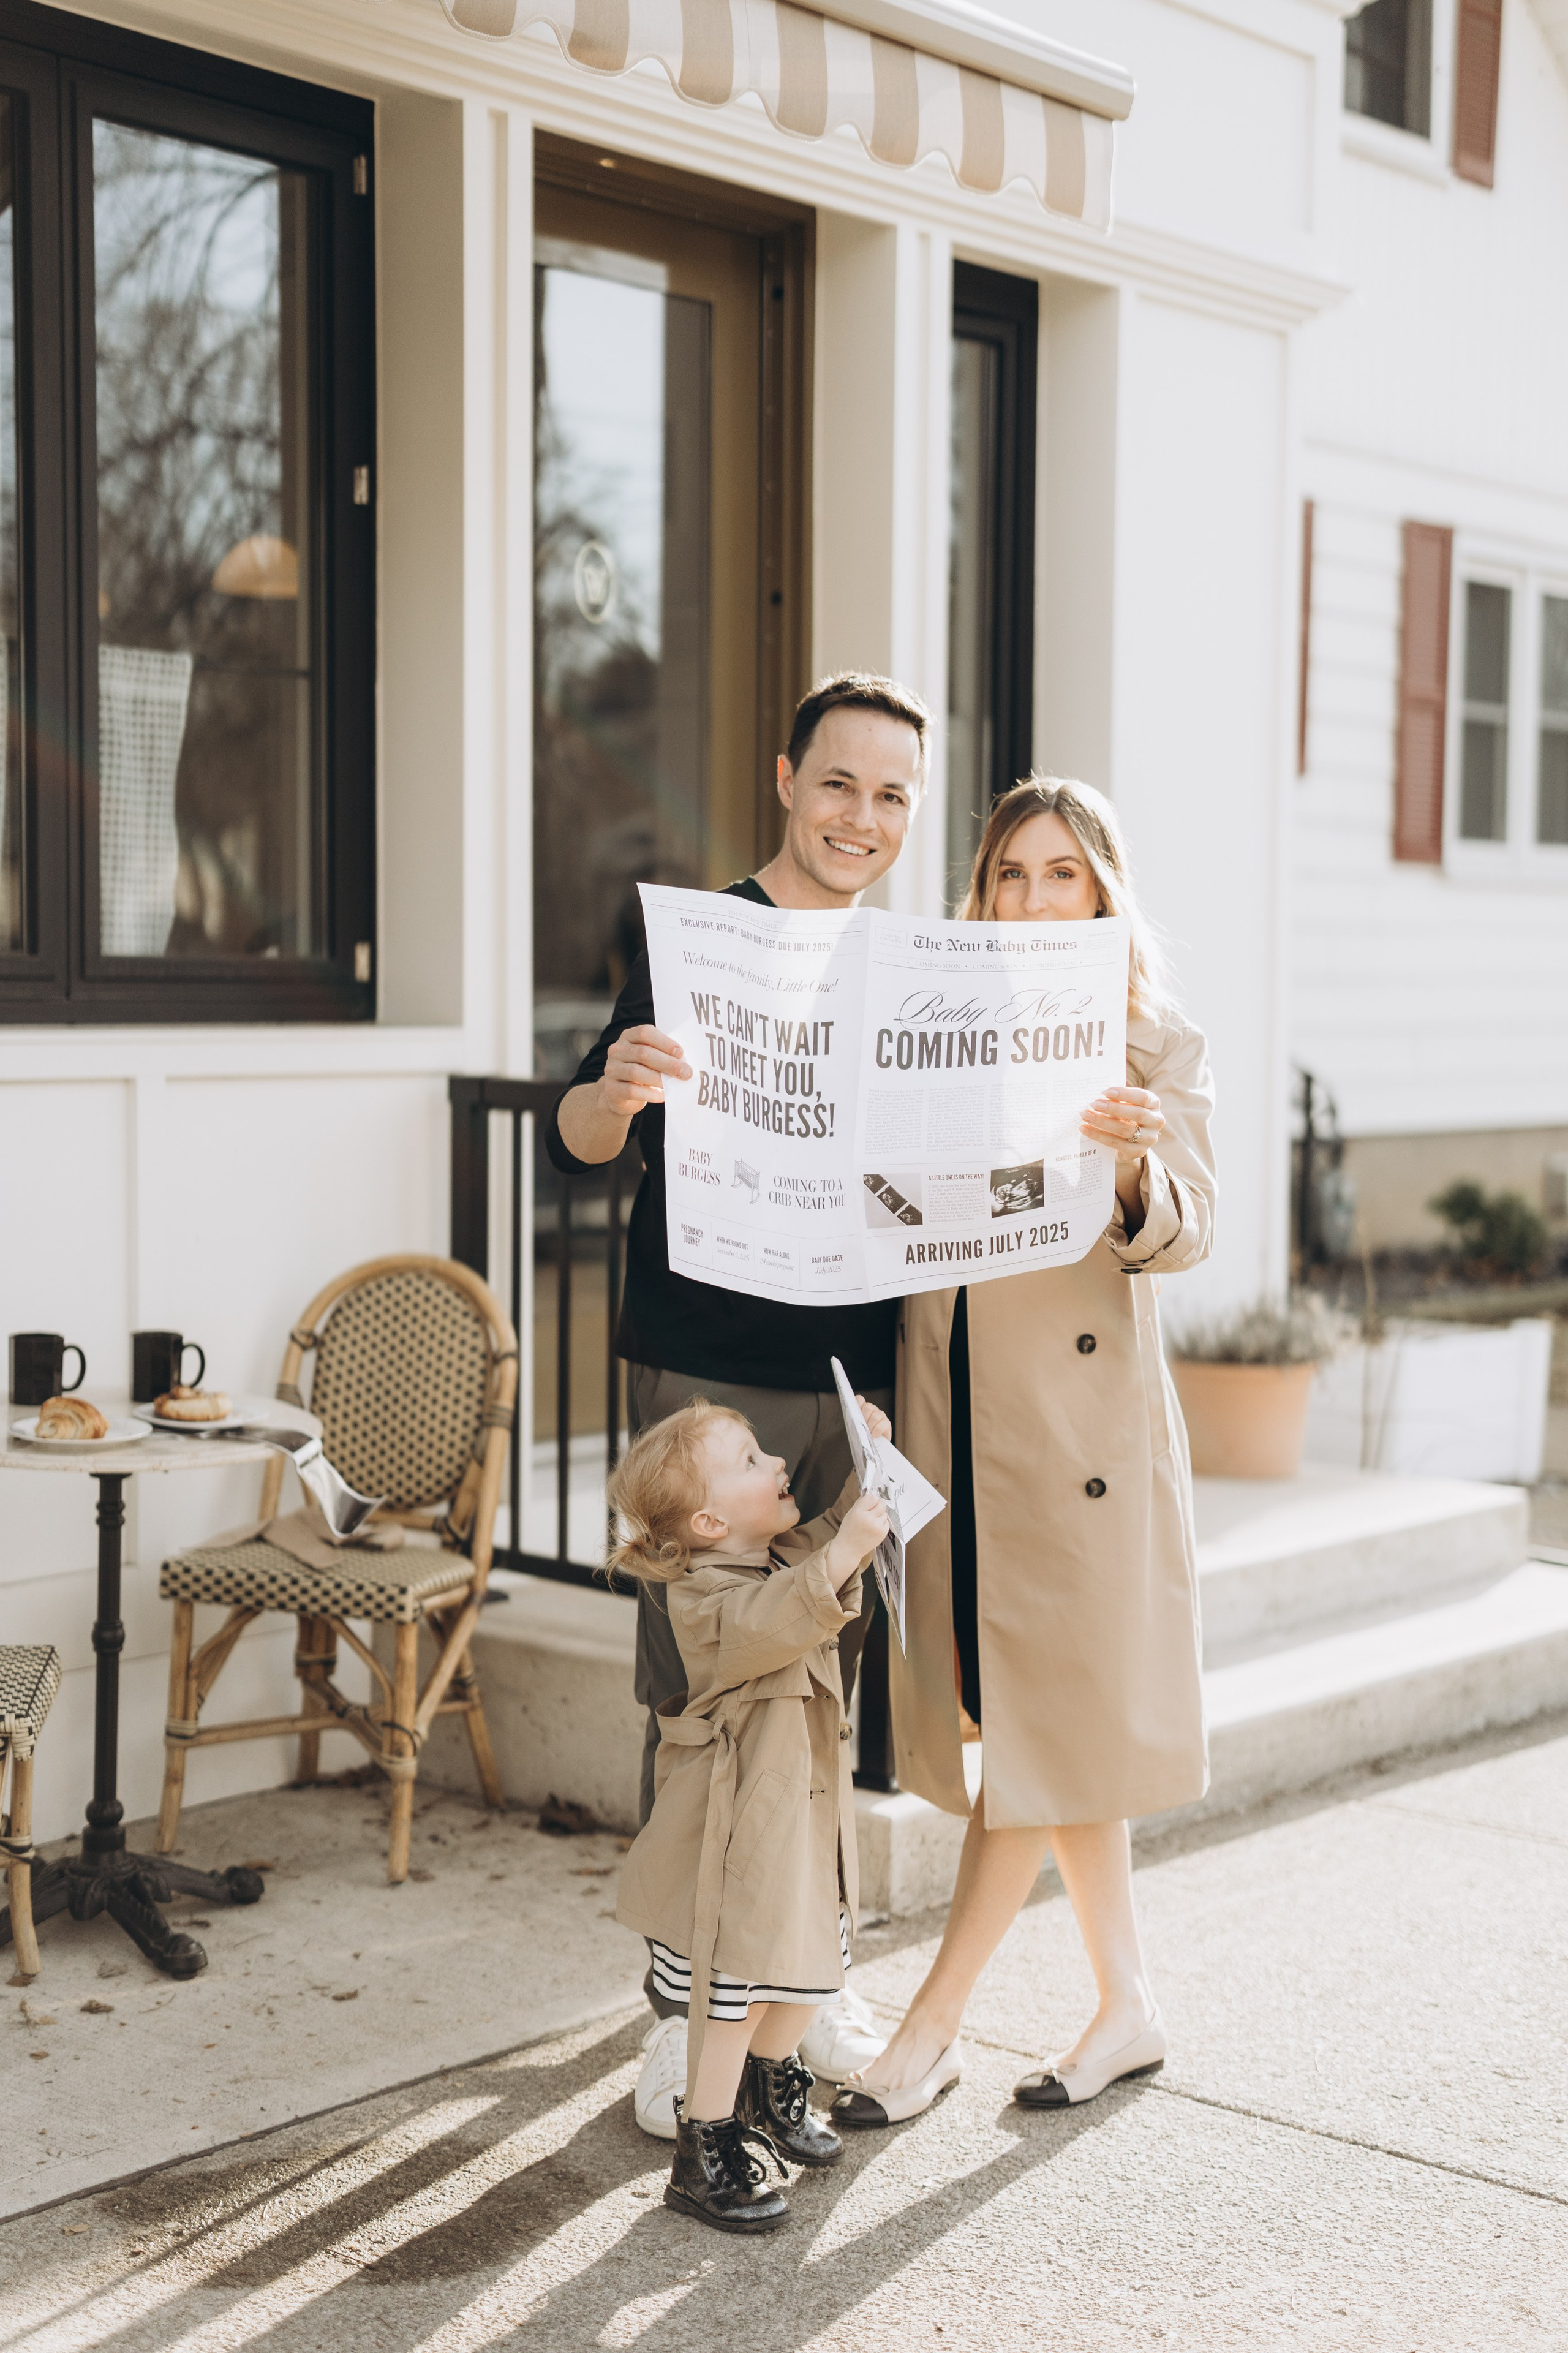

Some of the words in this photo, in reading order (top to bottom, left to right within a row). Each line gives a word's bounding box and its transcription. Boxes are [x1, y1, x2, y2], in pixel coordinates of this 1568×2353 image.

[750, 916, 760, 926] BABY
[761, 921, 777, 929] TIMES
[680, 917, 714, 930] EXCLUSIVE
[716, 923, 739, 936] REPORT:
[741, 929, 753, 941] BABY
[753, 934, 776, 949] BURGESS
[778, 941, 791, 951] DUE
[794, 943, 810, 952] JULY
[813, 943, 834, 952] 2025!
[913, 935, 943, 952] The
[946, 939, 981, 951] New
[986, 940, 1025, 955] Baby
[1030, 939, 1077, 951] Times
[683, 951, 728, 970] Welcome
[728, 962, 736, 973] to
[737, 964, 747, 978] the
[745, 969, 774, 991] family,
[777, 977, 807, 993] Little
[809, 978, 839, 993] One!
[893, 991, 988, 1035] Baby
[994, 989, 1076, 1023] No.
[1068, 995, 1093, 1014] 2
[690, 991, 723, 1029] WE
[727, 1000, 769, 1048] CAN'T
[774, 1019, 834, 1056] WAIT
[876, 1028, 998, 1070] COMING
[1011, 1020, 1105, 1064] SOON!
[704, 1032, 726, 1071] TO
[731, 1041, 767, 1089] MEET
[773, 1058, 822, 1102] YOU,
[697, 1070, 737, 1117] BABY
[742, 1087, 835, 1138] BURGESS!
[688, 1148, 714, 1166] BABY
[679, 1162, 720, 1187] BURGESS
[774, 1175, 816, 1193] COMING
[820, 1179, 835, 1192] TO
[837, 1178, 842, 1191] A
[769, 1190, 791, 1207] CRIB
[795, 1195, 825, 1209] NEAR
[829, 1193, 846, 1209] YOU
[680, 1223, 704, 1238] PREGNANCY
[684, 1234, 701, 1247] JOURNEY
[717, 1247, 735, 1257] November
[731, 1240, 742, 1248] FOUND
[906, 1239, 982, 1264] ARRIVING
[989, 1230, 1023, 1256] JULY
[1030, 1221, 1068, 1247] 2025
[779, 1251, 790, 1260] ALONG
